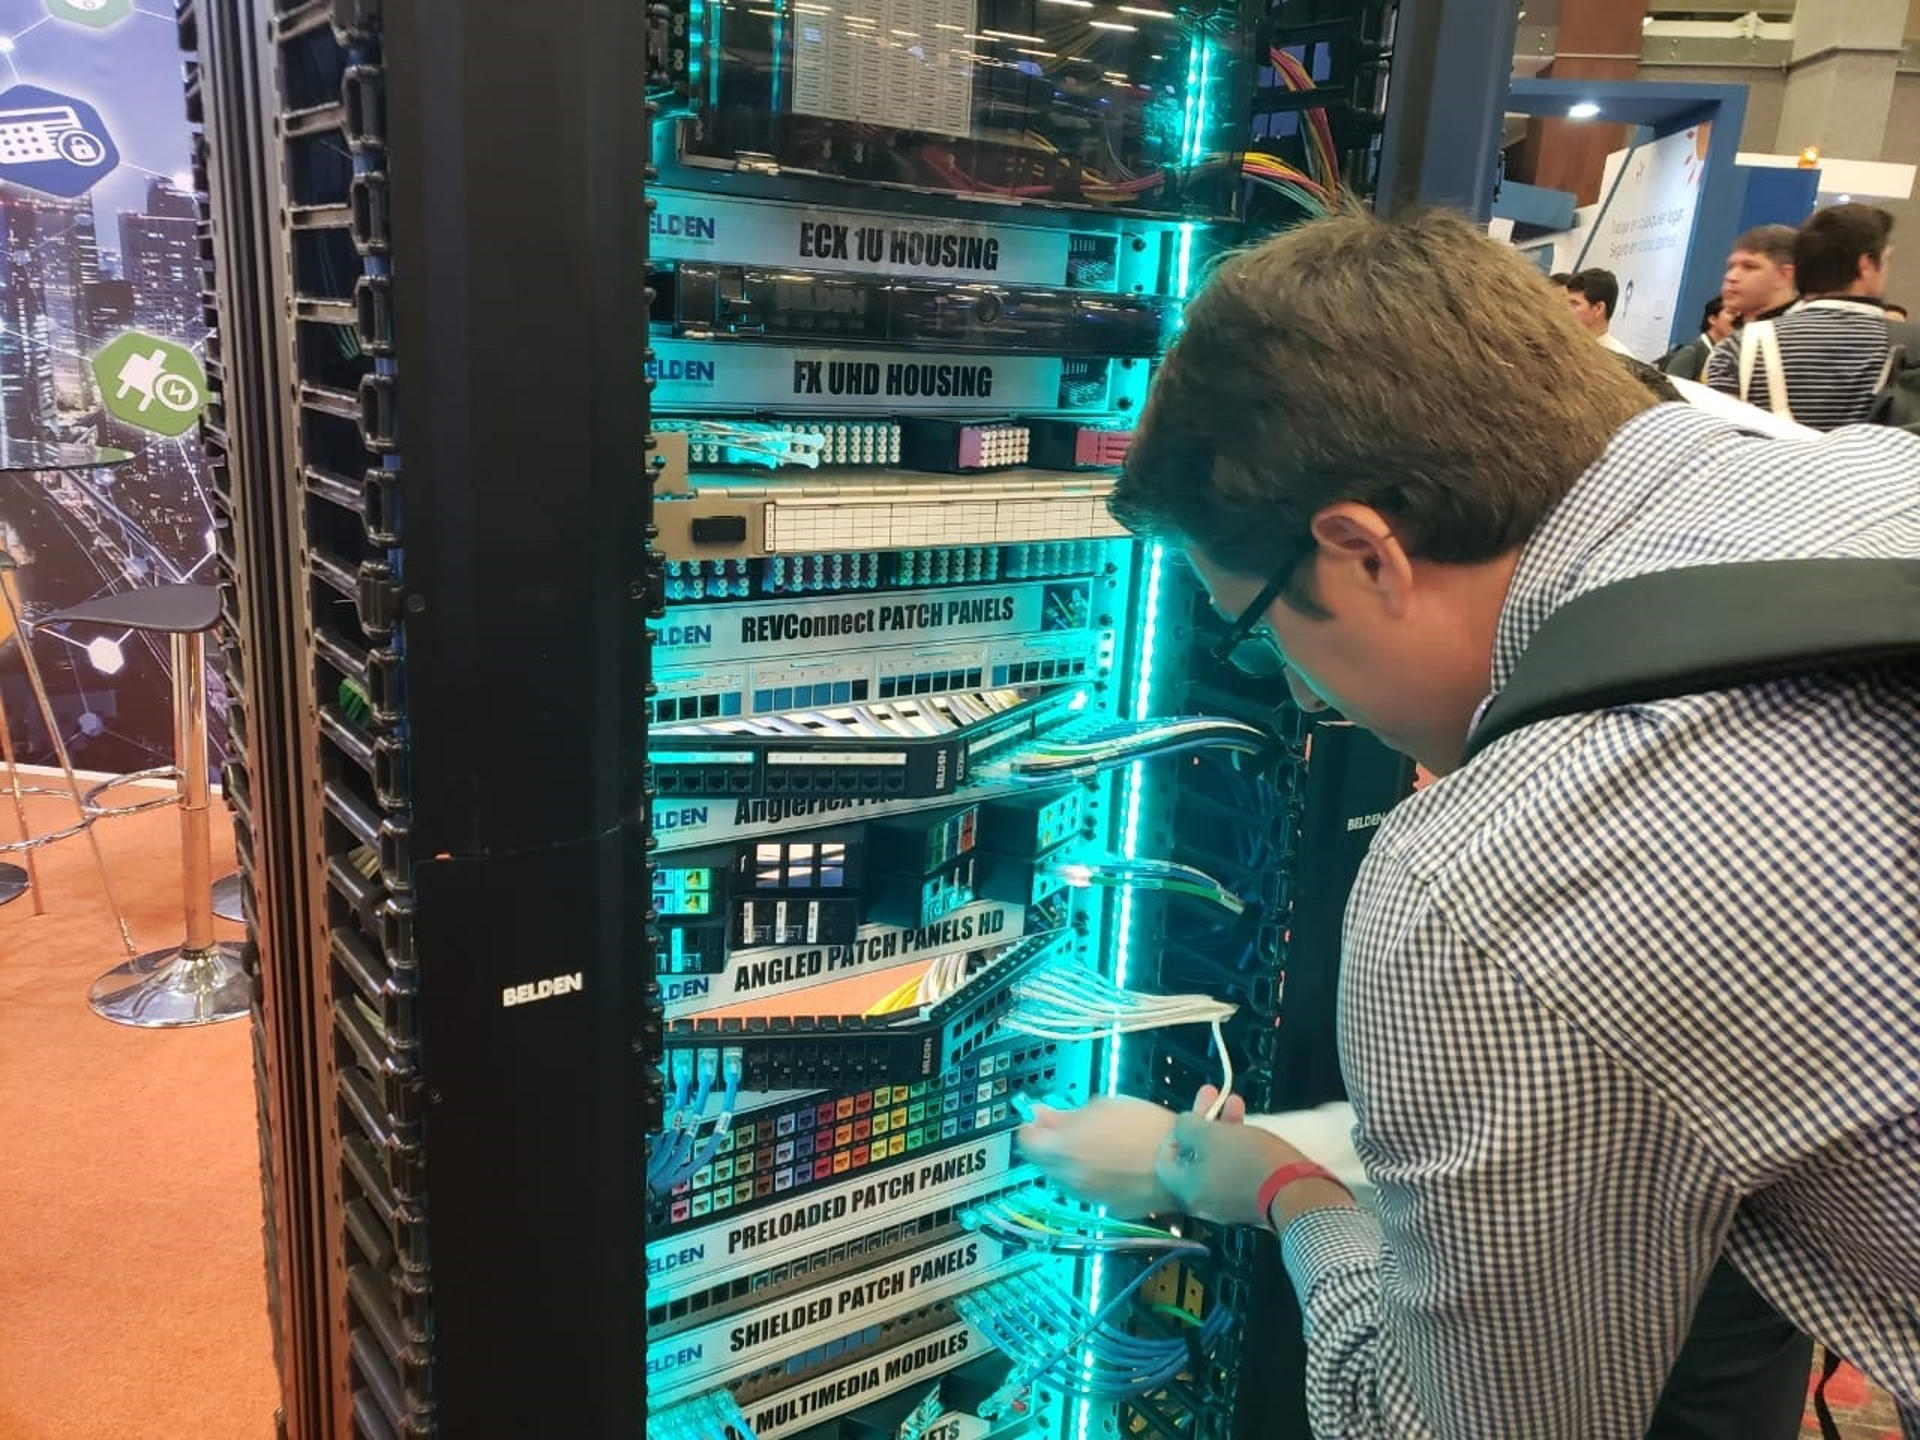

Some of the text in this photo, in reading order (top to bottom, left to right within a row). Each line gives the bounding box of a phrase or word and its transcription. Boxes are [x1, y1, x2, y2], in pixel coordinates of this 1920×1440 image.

[650, 213, 715, 239] ELDEN
[799, 221, 999, 271] ECX 1U HOUSING
[647, 359, 715, 381] ELDEN
[793, 360, 993, 398] FX UHD HOUSING
[653, 623, 712, 647] LDEN
[741, 596, 1014, 643] REVConnect PATCH PANELS
[654, 806, 708, 830] LDEN
[734, 910, 1005, 992] ANGLED PATCH PANELS HD
[503, 971, 582, 1007] BELDEN
[727, 1148, 987, 1252] PRELOADED PATCH PANELS
[647, 1244, 704, 1275] ELDEN
[730, 1243, 978, 1352] SHIELDED PATCH PANELS
[647, 1343, 703, 1375] ELDEN
[756, 1366, 880, 1435] MULTIMEDIA
[884, 1329, 969, 1383] MODULES
